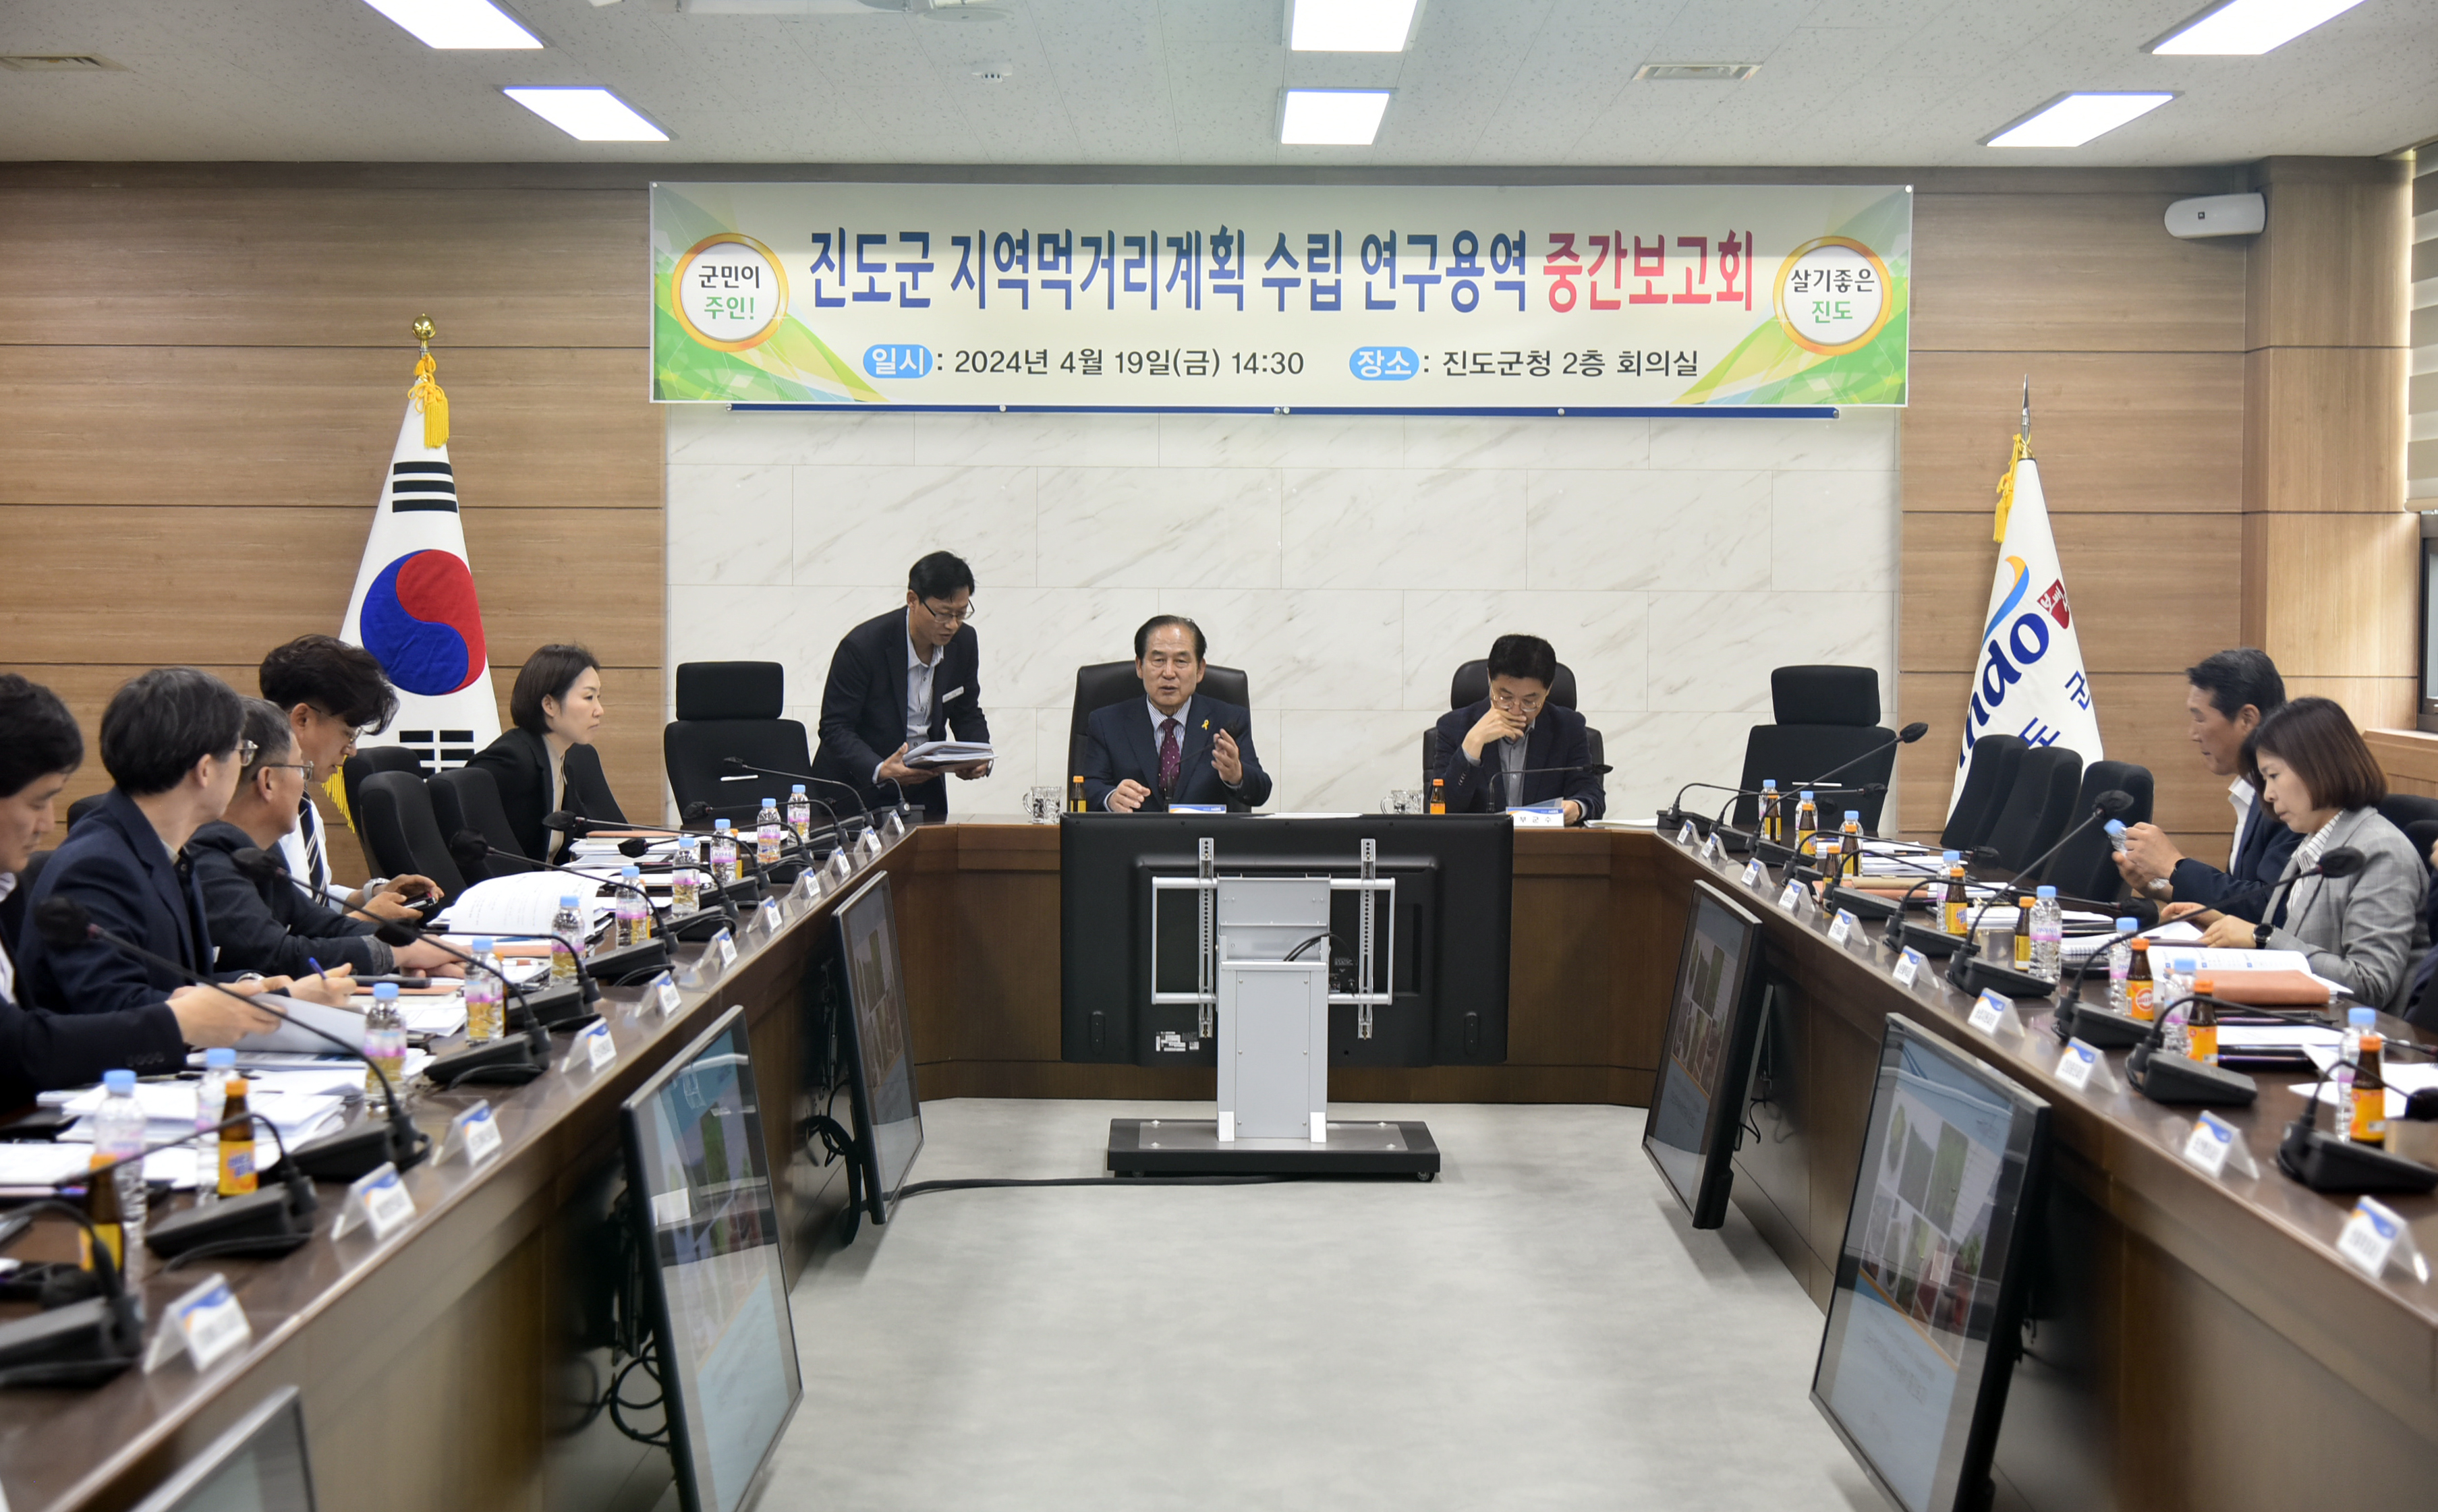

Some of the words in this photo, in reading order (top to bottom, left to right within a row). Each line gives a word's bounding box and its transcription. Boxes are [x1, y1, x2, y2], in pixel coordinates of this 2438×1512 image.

[698, 265, 760, 289] 군민이
[810, 227, 934, 308] 진도군
[950, 225, 1245, 312] 지역먹거리계획
[1261, 229, 1342, 312] 수립
[1360, 229, 1526, 313] 연구용역
[1543, 229, 1753, 313] 중간보고회
[1790, 268, 1876, 293] 살기좋은
[704, 296, 754, 320] 주인!
[1811, 301, 1853, 324] 진도
[872, 348, 924, 375] 일시
[955, 349, 1048, 375] 2024년
[1060, 348, 1102, 376] 4월
[1115, 348, 1220, 378] 19일(금)
[1232, 351, 1304, 375] 14:30
[1357, 349, 1411, 378] 장소
[1442, 350, 1550, 377] 진도군청
[1562, 349, 1606, 377] 2층
[1617, 350, 1699, 377] 회의실
